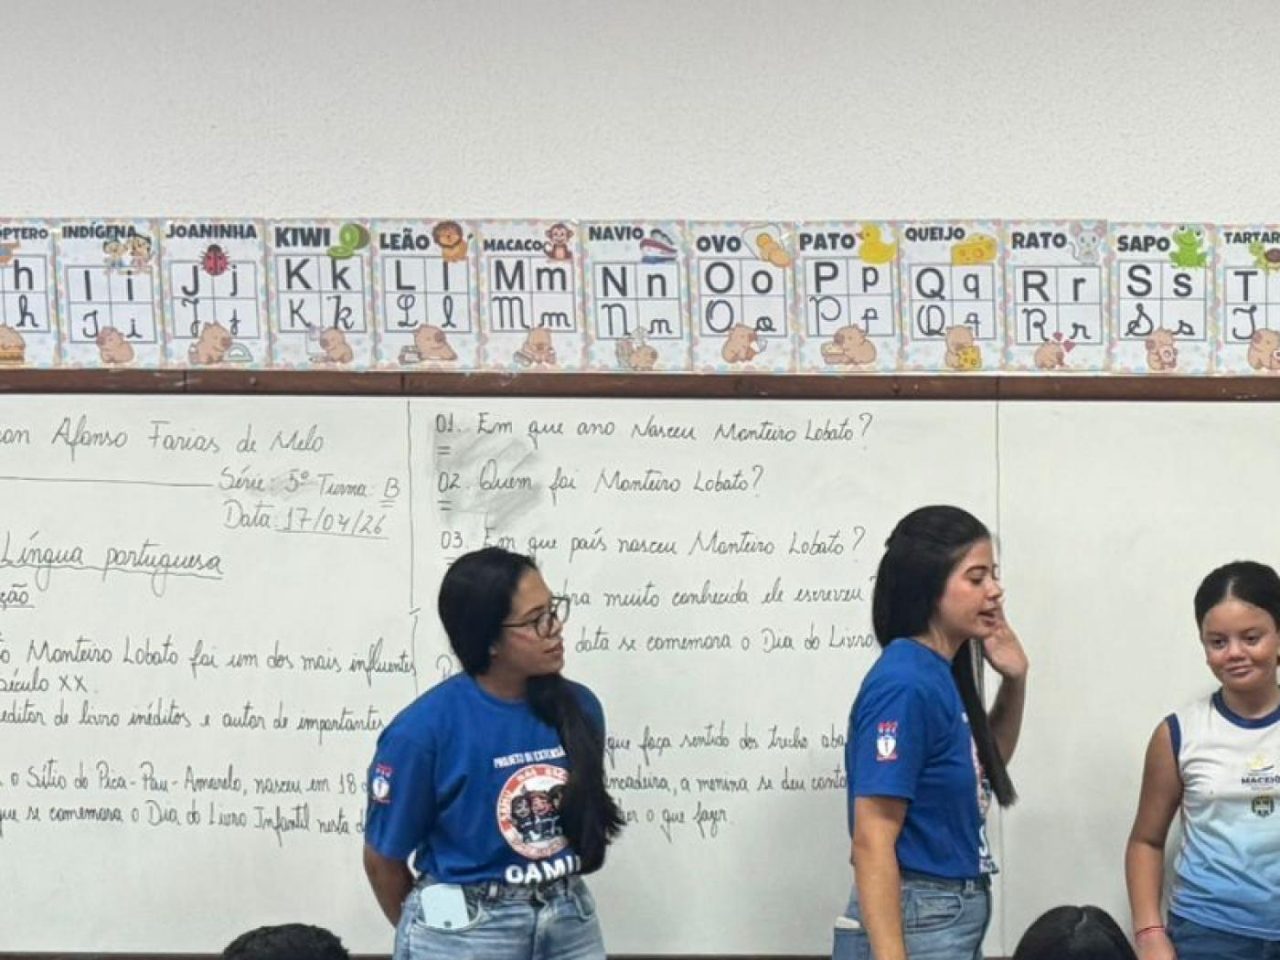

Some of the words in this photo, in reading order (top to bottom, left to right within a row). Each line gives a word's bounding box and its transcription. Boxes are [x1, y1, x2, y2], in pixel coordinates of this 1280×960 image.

[62, 222, 137, 239] INDÍGENA
[166, 224, 257, 239] JOANINHA
[275, 226, 330, 248] KIWI
[380, 227, 430, 250] LEÃO
[484, 239, 542, 251] MACACO
[589, 226, 644, 241] NAVIO
[696, 234, 742, 252] OVO
[800, 233, 856, 251] PATO
[905, 227, 966, 241] QUEIJO
[1012, 232, 1067, 249] RATO
[1117, 235, 1170, 252] SAPO
[14, 259, 33, 290] h
[181, 265, 199, 297] J
[285, 258, 312, 290] K
[331, 258, 351, 290] k
[396, 260, 416, 291] L
[495, 260, 524, 291] M
[536, 267, 566, 291] m
[602, 266, 627, 297] N
[647, 273, 666, 297] n
[705, 262, 734, 294] O
[751, 270, 773, 294] o
[815, 261, 839, 293] P
[862, 266, 879, 293] p
[916, 267, 945, 300] Q
[963, 273, 980, 299] q
[1023, 270, 1050, 302] R
[1073, 277, 1086, 302] r
[1127, 264, 1152, 297] S
[1173, 273, 1192, 297] s
[1233, 271, 1258, 301] T
[51, 413, 128, 462] Afonso
[478, 412, 513, 434] Em
[528, 420, 564, 450] que
[577, 421, 616, 436] ano
[714, 420, 797, 442] Monteiro
[383, 477, 401, 498] B
[479, 458, 532, 491] Quem
[594, 468, 681, 493] Monteiro
[569, 527, 607, 563] país
[618, 537, 678, 555] nasceu
[687, 530, 775, 555] Monteiro
[1, 530, 84, 592] Língua
[102, 538, 224, 598] portuguesa
[604, 580, 660, 607] muito
[26, 635, 113, 664] Monteiro
[123, 634, 179, 666] Lobato
[226, 652, 259, 669] um
[646, 634, 732, 651] comemora
[761, 627, 795, 653] Dia
[222, 700, 266, 728] autor
[339, 772, 357, 796] 18
[696, 776, 750, 792] menina
